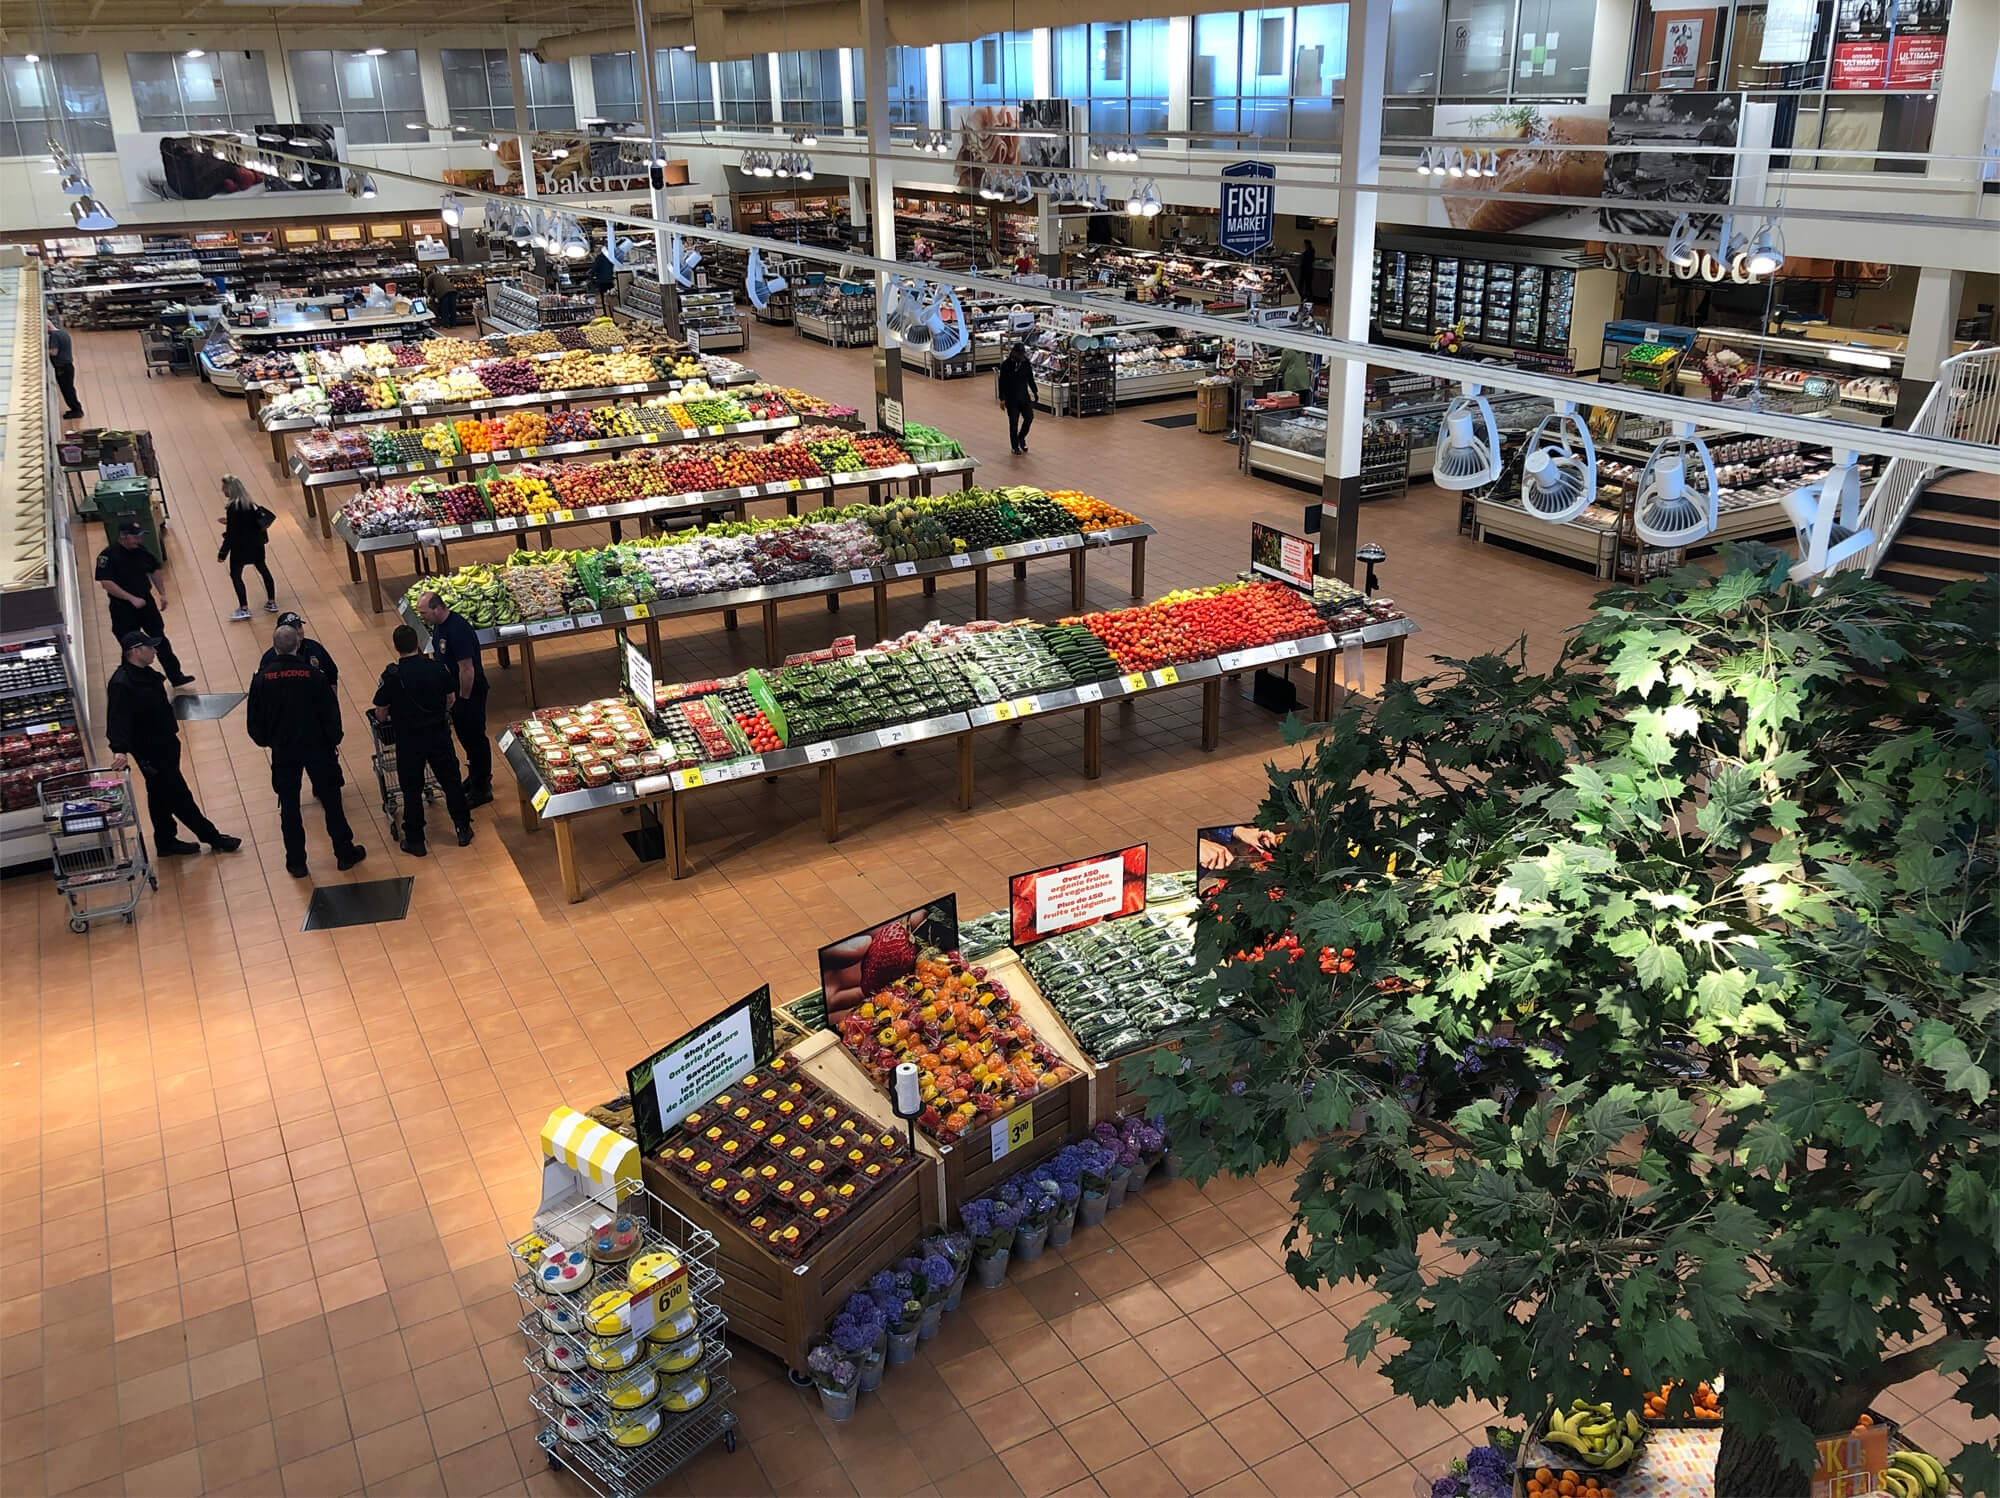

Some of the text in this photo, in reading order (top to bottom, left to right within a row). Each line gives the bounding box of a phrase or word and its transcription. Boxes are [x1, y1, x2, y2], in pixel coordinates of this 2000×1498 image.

[1671, 55, 1688, 64] DAY
[1843, 58, 1880, 66] ULTIMATE
[1899, 52, 1939, 60] ULTIMATE
[543, 169, 632, 194] bakery
[1227, 186, 1268, 217] FISH
[1227, 215, 1267, 233] MARKET
[1050, 873, 1110, 893] organic fruits
[1062, 869, 1099, 884] Over 150
[1047, 880, 1113, 902] and vegetables
[1057, 900, 1075, 909] Plus
[1088, 892, 1103, 901] 150
[1043, 895, 1116, 920] fruits et légumes
[1073, 910, 1086, 918] bio
[668, 1030, 739, 1080] Ontario growers
[684, 1042, 706, 1060] Shop
[680, 1056, 733, 1095] les produits
[685, 1051, 726, 1082] Savourez
[666, 1102, 678, 1113] de
[695, 1053, 748, 1094] producteurs
[648, 1277, 669, 1295] SALE
